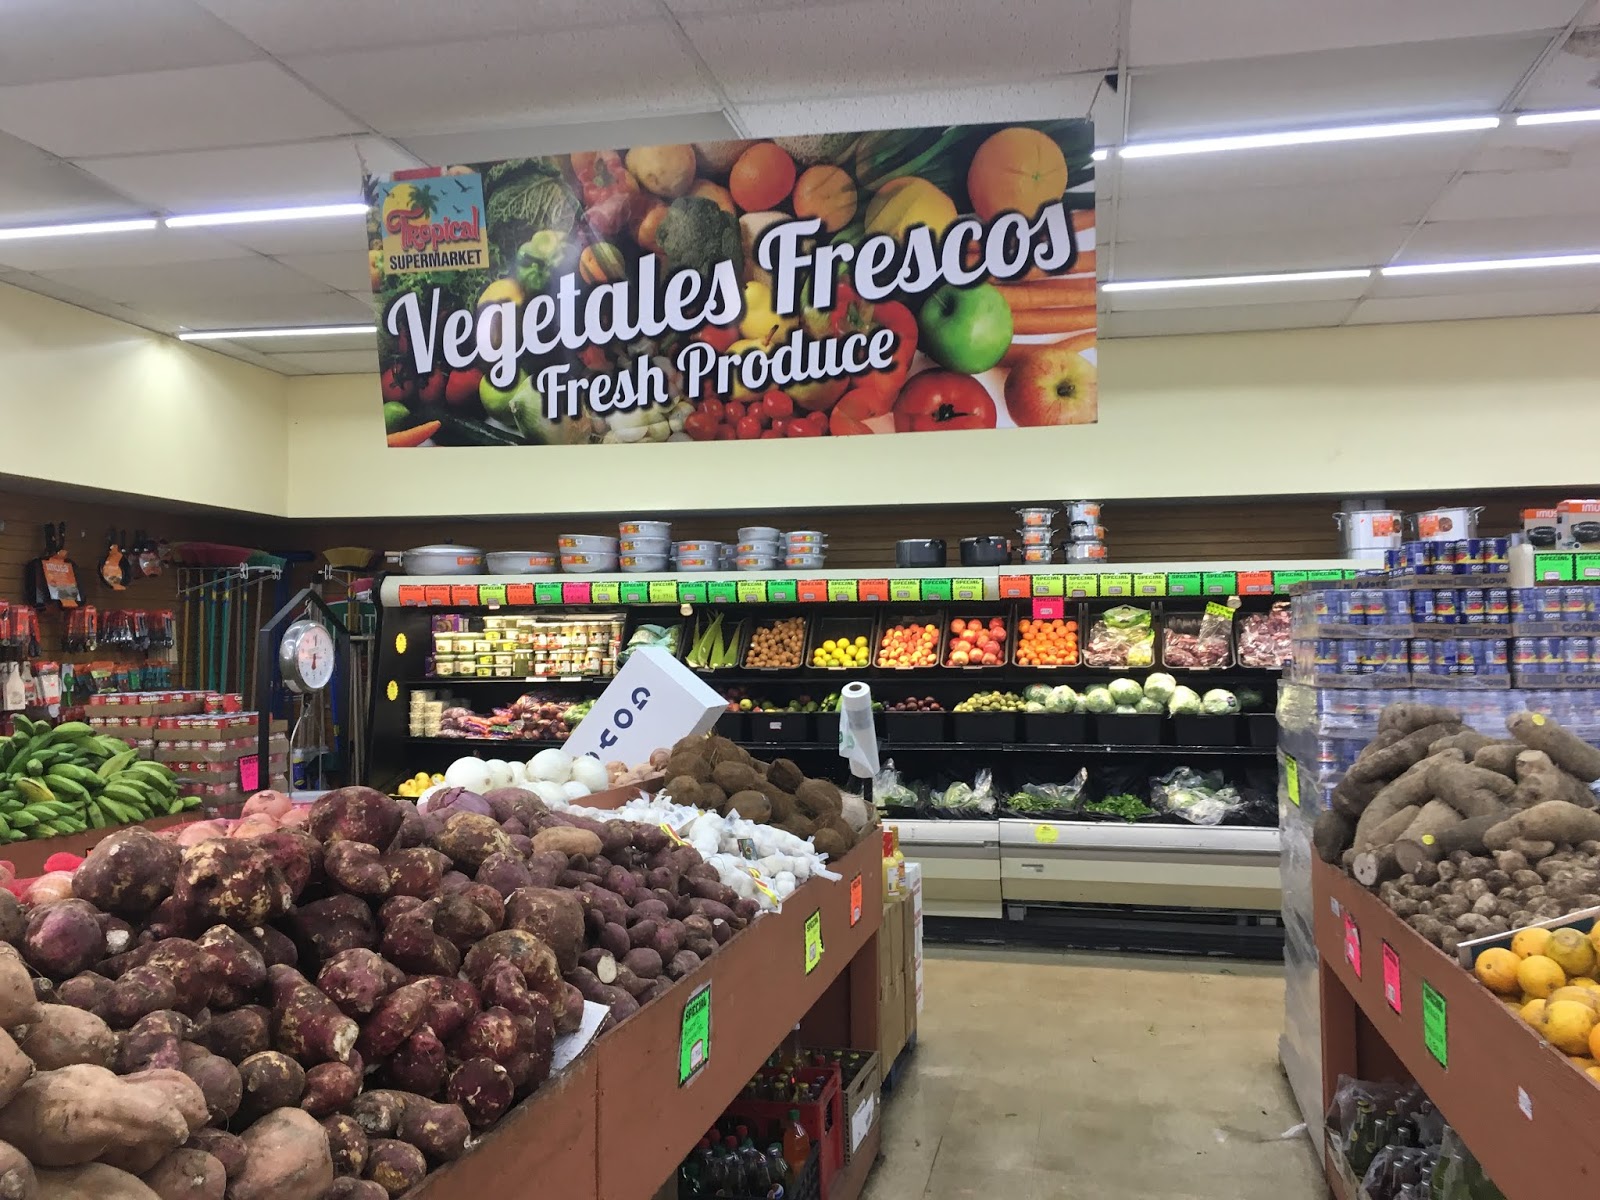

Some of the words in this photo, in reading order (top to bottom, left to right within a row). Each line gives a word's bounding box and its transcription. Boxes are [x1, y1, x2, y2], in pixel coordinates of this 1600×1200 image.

[386, 206, 480, 251] Tropical
[390, 250, 482, 270] SUPERMARKET
[386, 251, 742, 389] Vegetales
[757, 200, 1073, 315] Frescos
[536, 361, 668, 419] Fresh
[676, 327, 894, 399] Produce
[685, 998, 707, 1022] SPECIAL
